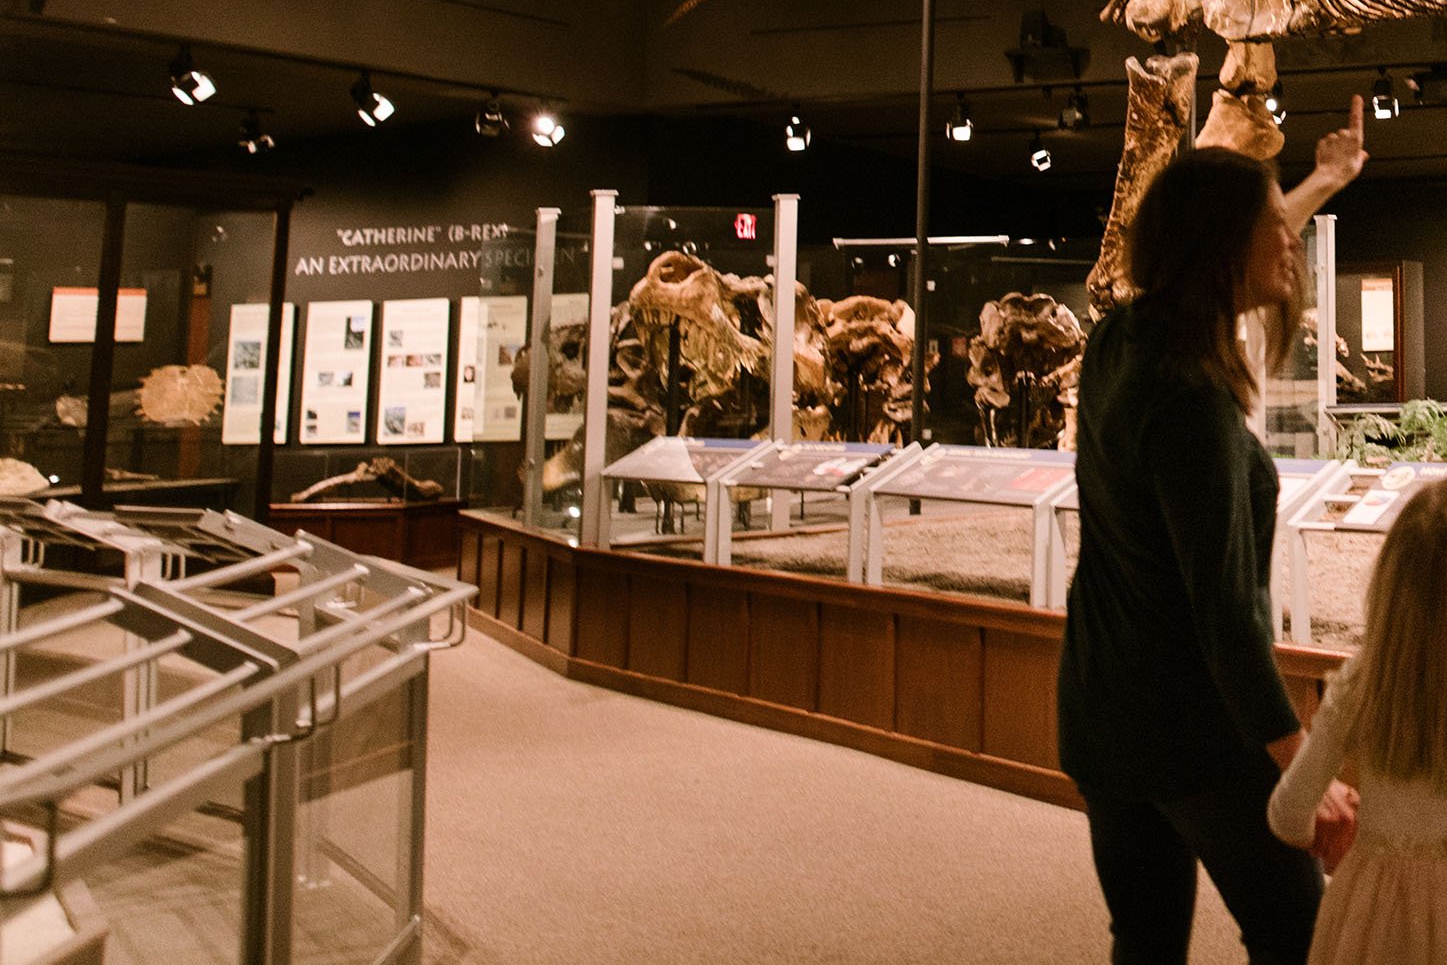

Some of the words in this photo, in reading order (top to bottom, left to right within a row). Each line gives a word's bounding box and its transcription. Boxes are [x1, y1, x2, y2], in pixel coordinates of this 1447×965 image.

[336, 225, 441, 246] "CATHERINE"
[295, 256, 324, 276] AN
[328, 250, 481, 276] EXTRAORDINARY
[484, 245, 575, 269] SPECIN
